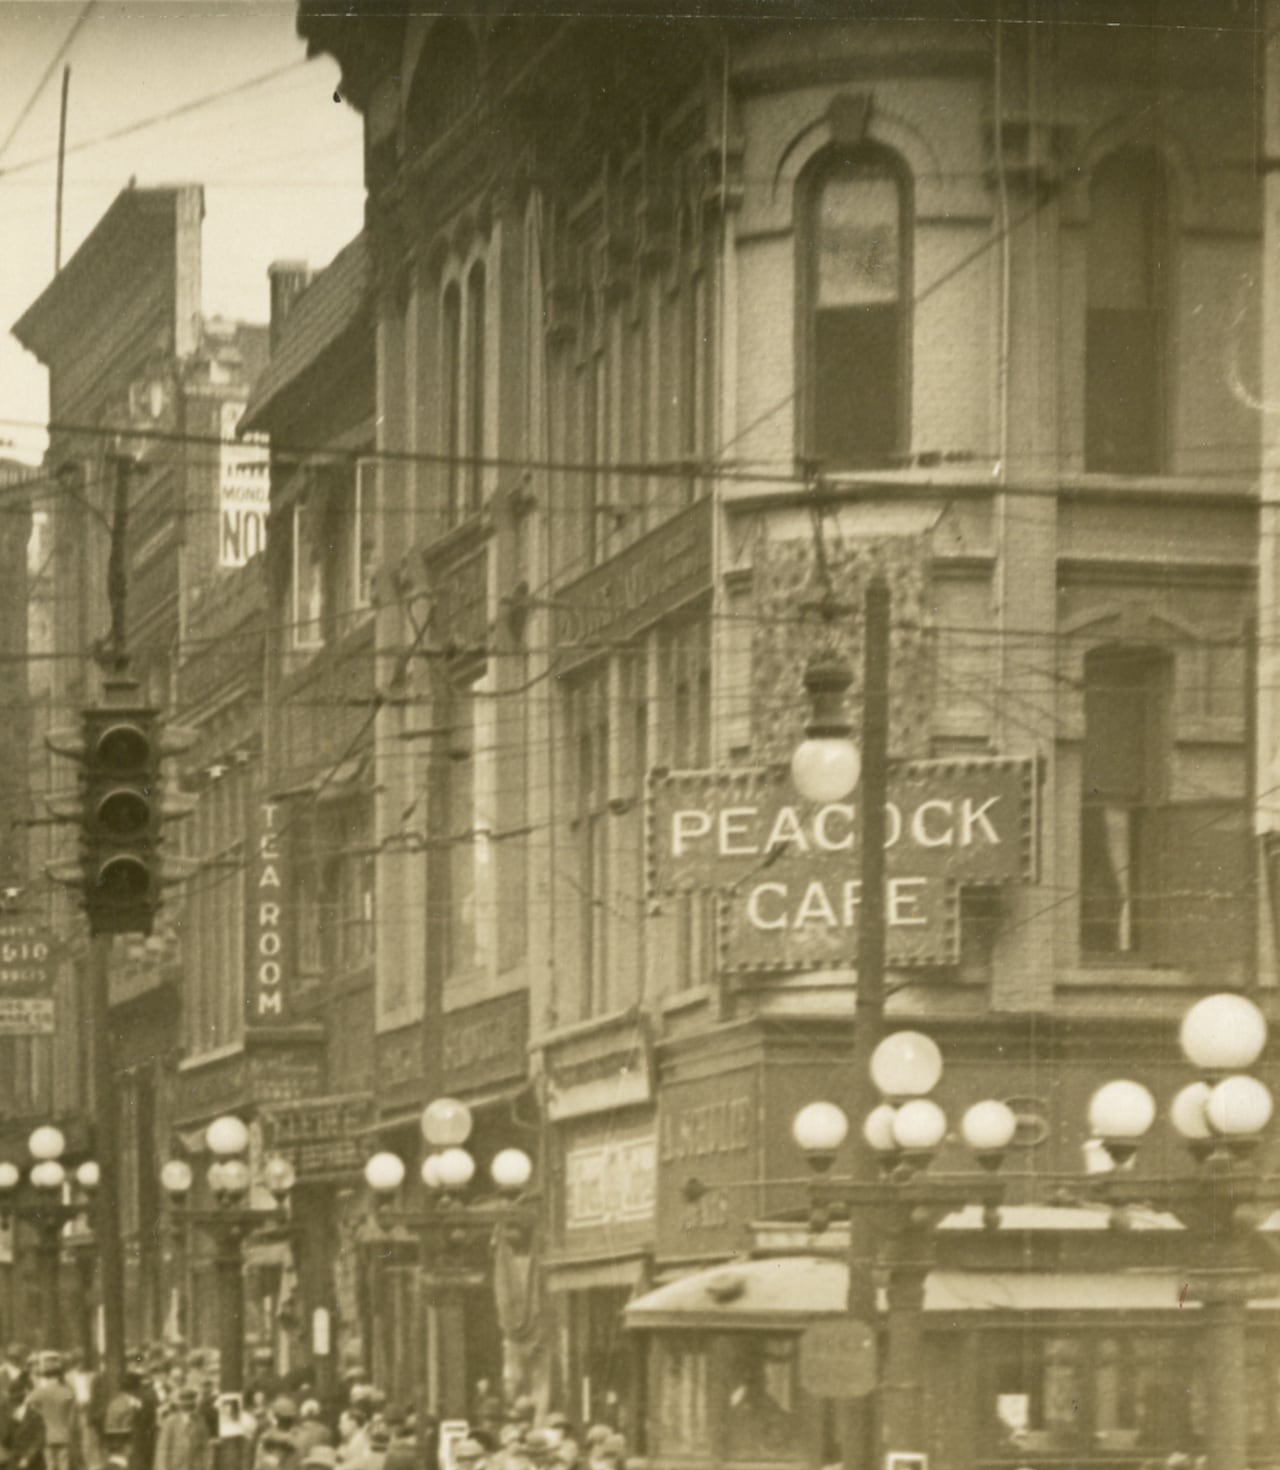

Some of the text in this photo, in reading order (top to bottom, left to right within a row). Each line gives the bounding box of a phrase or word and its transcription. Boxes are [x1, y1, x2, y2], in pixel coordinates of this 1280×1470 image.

[222, 510, 266, 562] NO
[257, 804, 283, 1016] TEA ROOM
